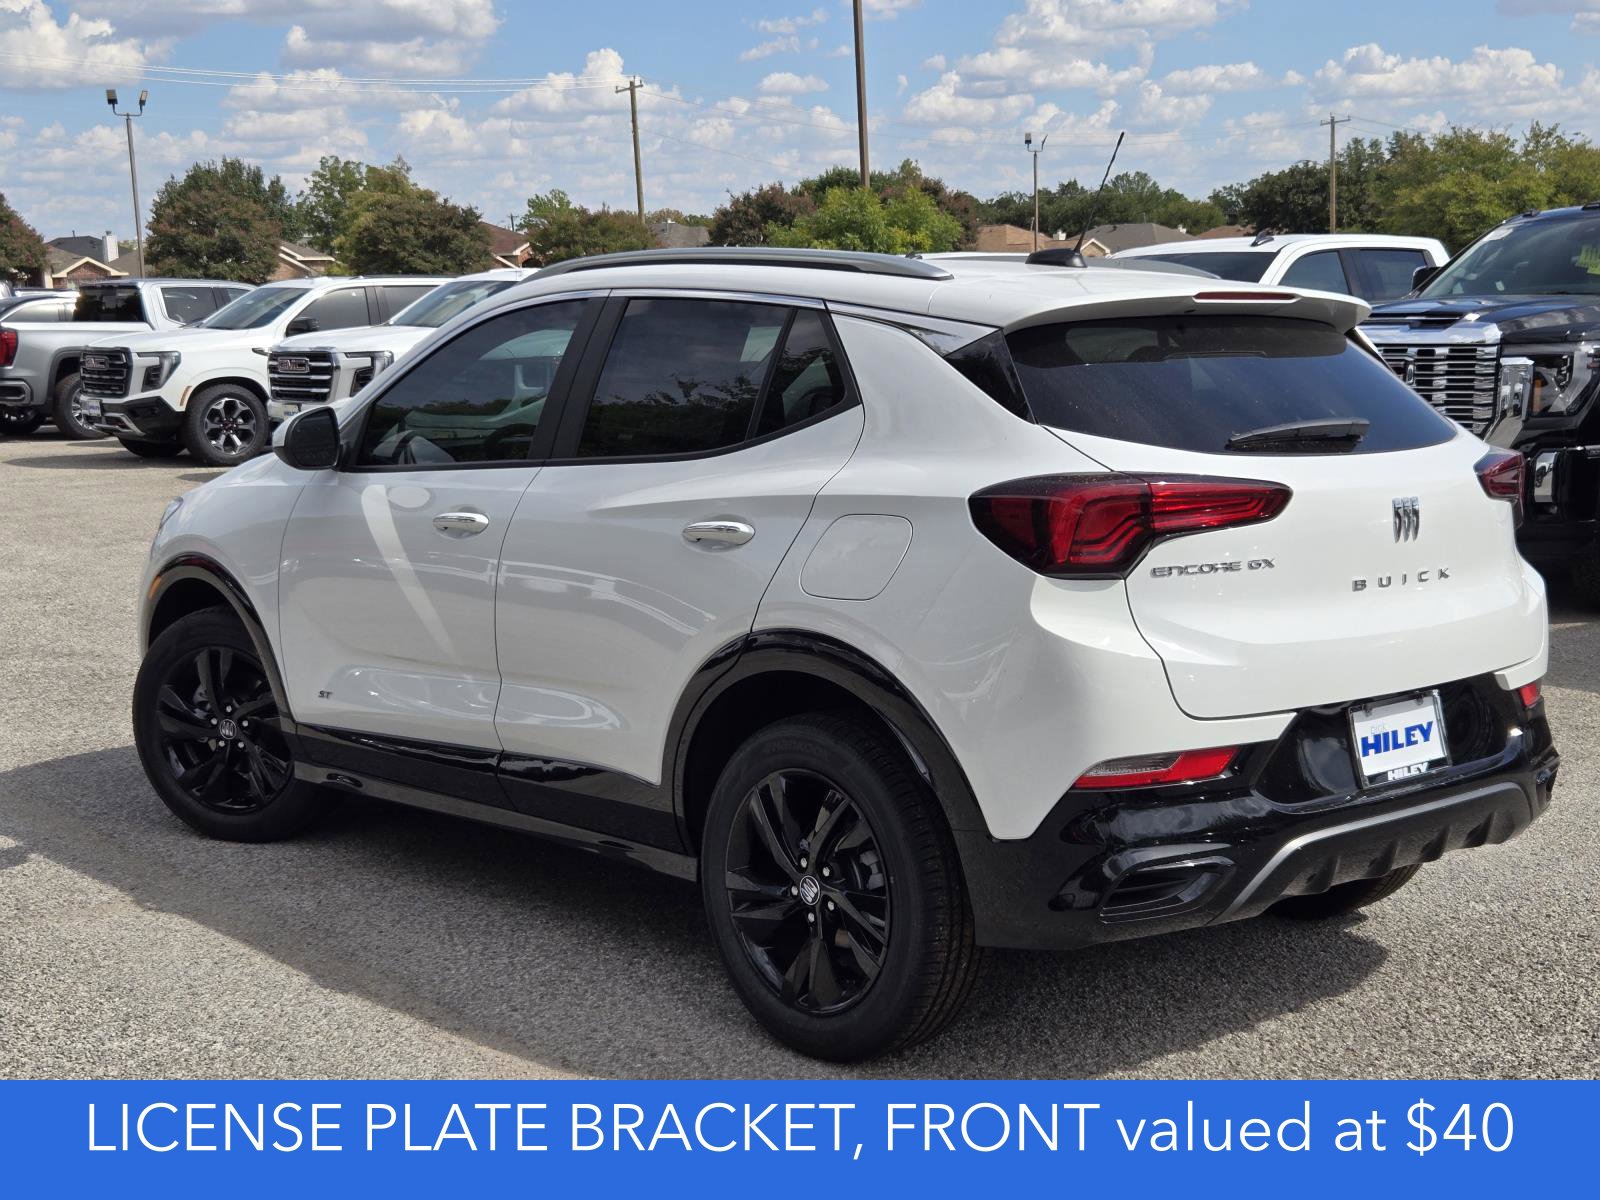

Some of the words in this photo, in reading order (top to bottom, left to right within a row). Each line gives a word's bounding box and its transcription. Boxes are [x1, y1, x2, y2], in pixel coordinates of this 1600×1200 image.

[279, 359, 306, 370] GMC
[1150, 561, 1242, 578] ENCORE
[1247, 558, 1275, 570] GX
[1352, 567, 1450, 592] BUICK
[318, 690, 333, 699] ST
[1361, 721, 1434, 758] HILEY
[1387, 761, 1429, 781] HILEY
